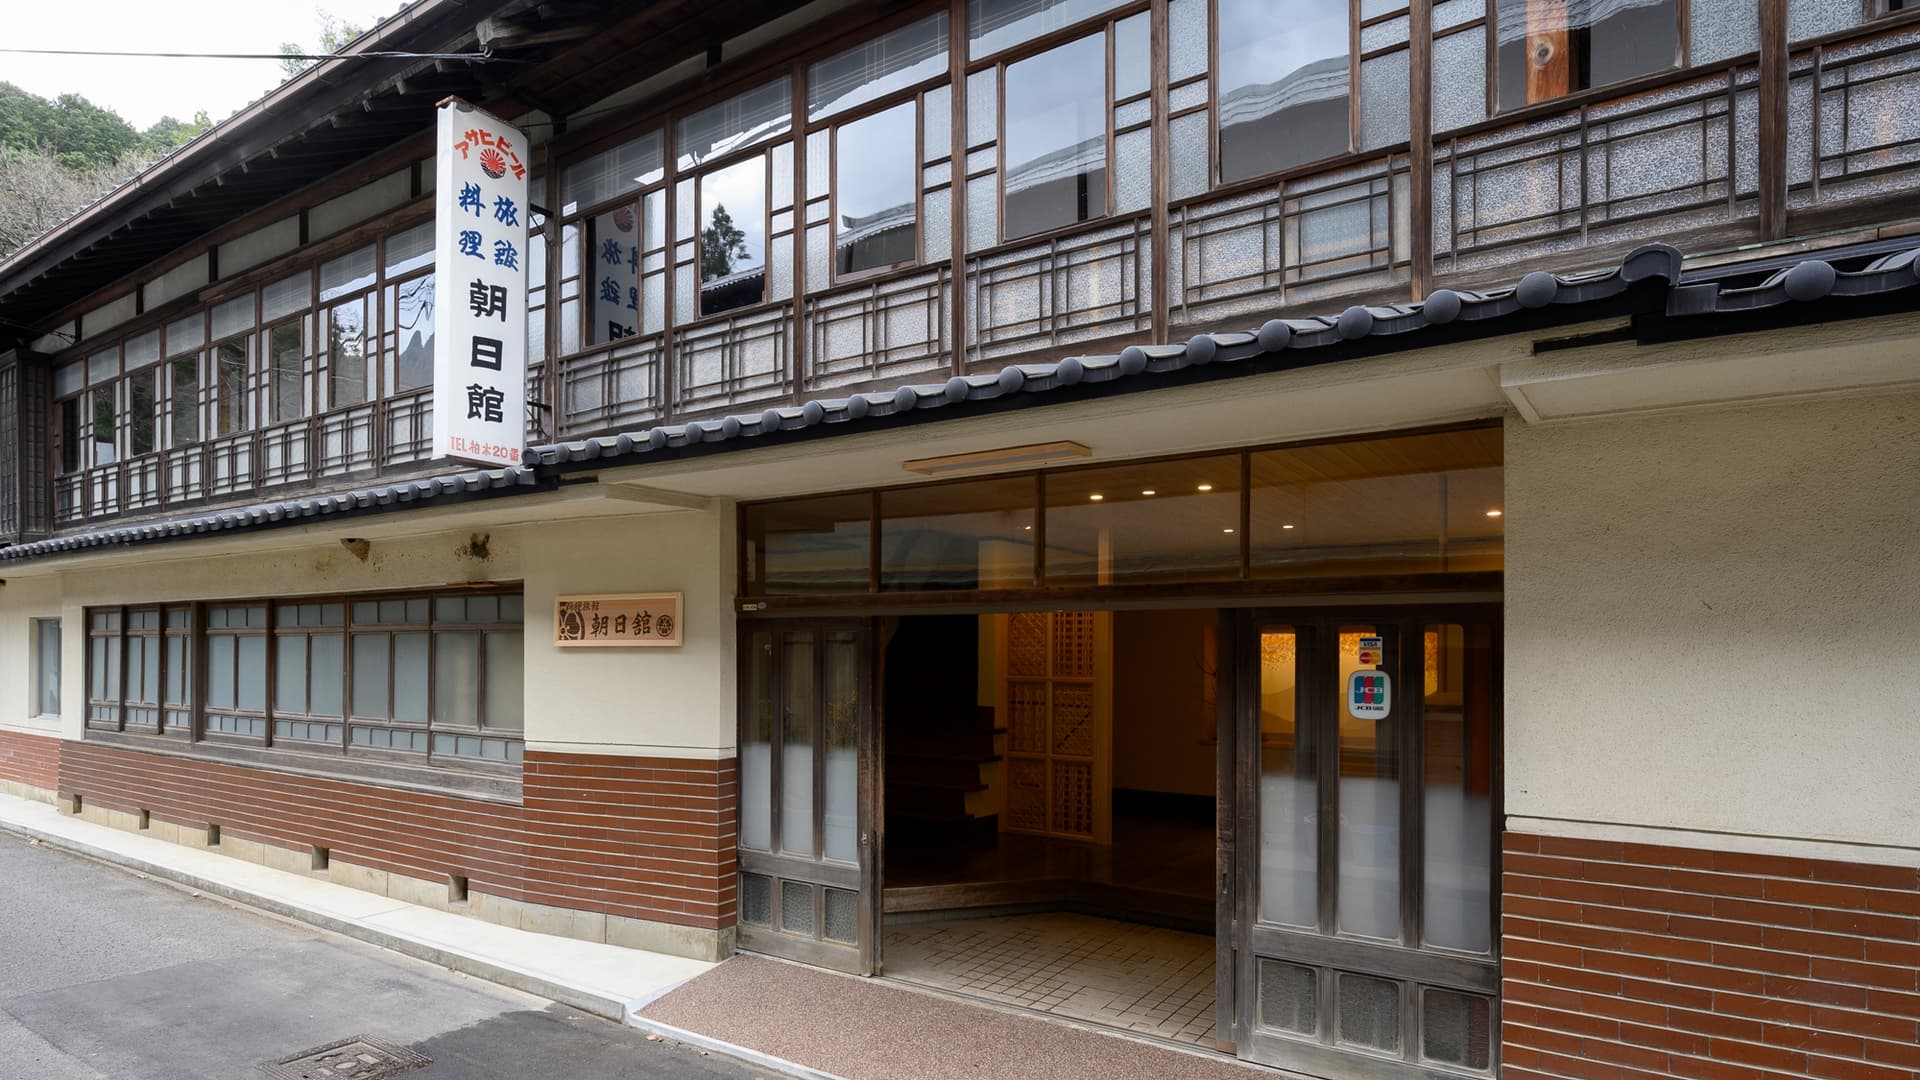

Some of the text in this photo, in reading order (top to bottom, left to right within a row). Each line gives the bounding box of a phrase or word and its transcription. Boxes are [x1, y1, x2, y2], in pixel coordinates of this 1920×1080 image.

[454, 129, 526, 181] アサヒビール
[458, 181, 486, 260] 料理
[466, 278, 507, 423] 朝日館
